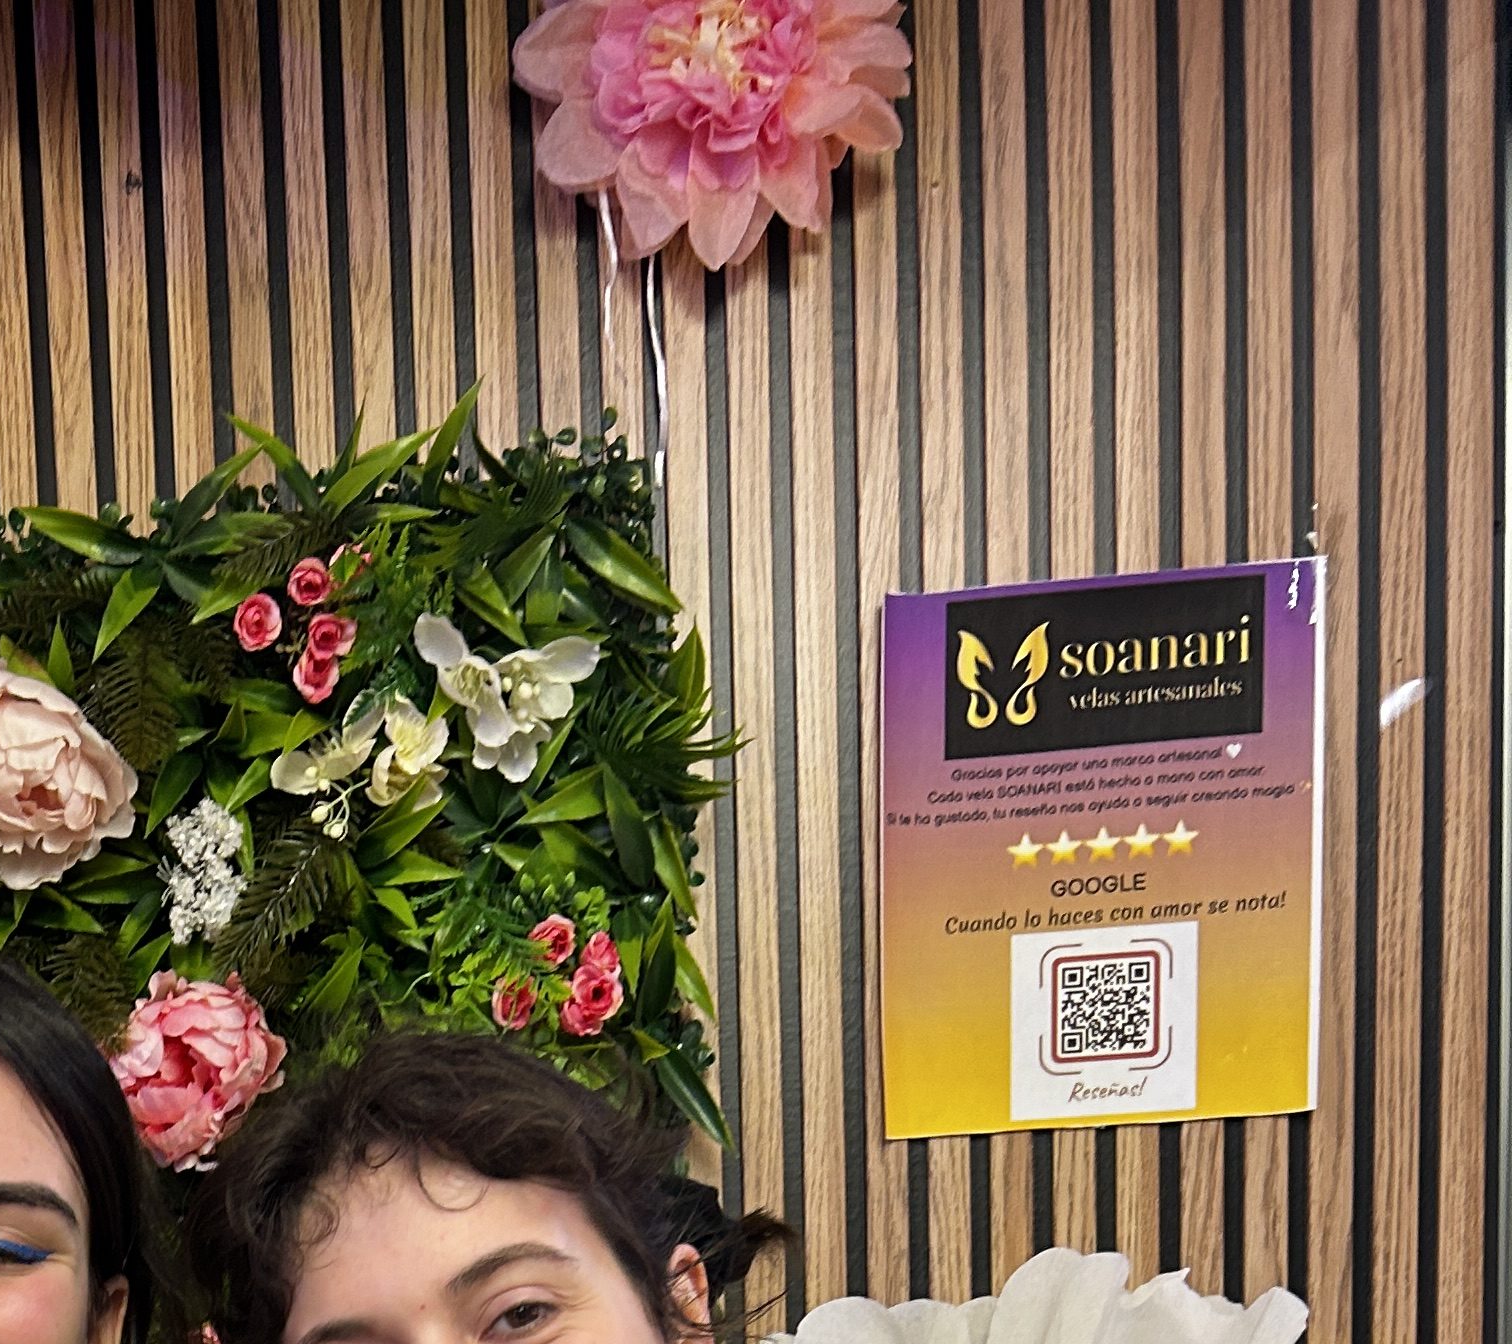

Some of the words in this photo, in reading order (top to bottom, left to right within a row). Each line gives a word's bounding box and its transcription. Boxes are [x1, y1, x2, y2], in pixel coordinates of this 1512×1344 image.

[1058, 614, 1251, 679] soanari
[1068, 686, 1121, 710] velas
[1124, 675, 1243, 706] artesanales
[951, 767, 1003, 782] Gracias
[1005, 764, 1029, 781] por
[1032, 761, 1078, 778] apoyar
[1082, 759, 1108, 770] una
[1111, 755, 1154, 768] marca
[1157, 746, 1223, 763] artesanal
[927, 790, 963, 804] Cada
[966, 786, 993, 800] vela
[996, 780, 1061, 799] SOANARI
[1098, 774, 1141, 791] hecha
[1144, 775, 1154, 786] a
[1157, 771, 1195, 785] mano
[1198, 768, 1224, 781] con
[914, 811, 931, 826] ha
[933, 807, 990, 828] gustado,
[992, 806, 1006, 820] tu
[1008, 801, 1056, 819] reseña
[1059, 801, 1085, 816] nos
[1088, 796, 1129, 815] ayuda
[1132, 796, 1143, 808] a
[1146, 789, 1188, 809] seguir
[1191, 786, 1248, 804] creando
[1252, 783, 1295, 800] magia
[1049, 872, 1148, 898] GOOGLE
[944, 910, 1017, 936] Cuando
[1023, 907, 1041, 929] lo
[1048, 905, 1104, 927] haces
[1109, 904, 1144, 922] con
[1150, 900, 1203, 920] amor
[1206, 899, 1229, 915] se
[1235, 889, 1287, 912] nota!
[1067, 1075, 1149, 1104] Reseñas!
